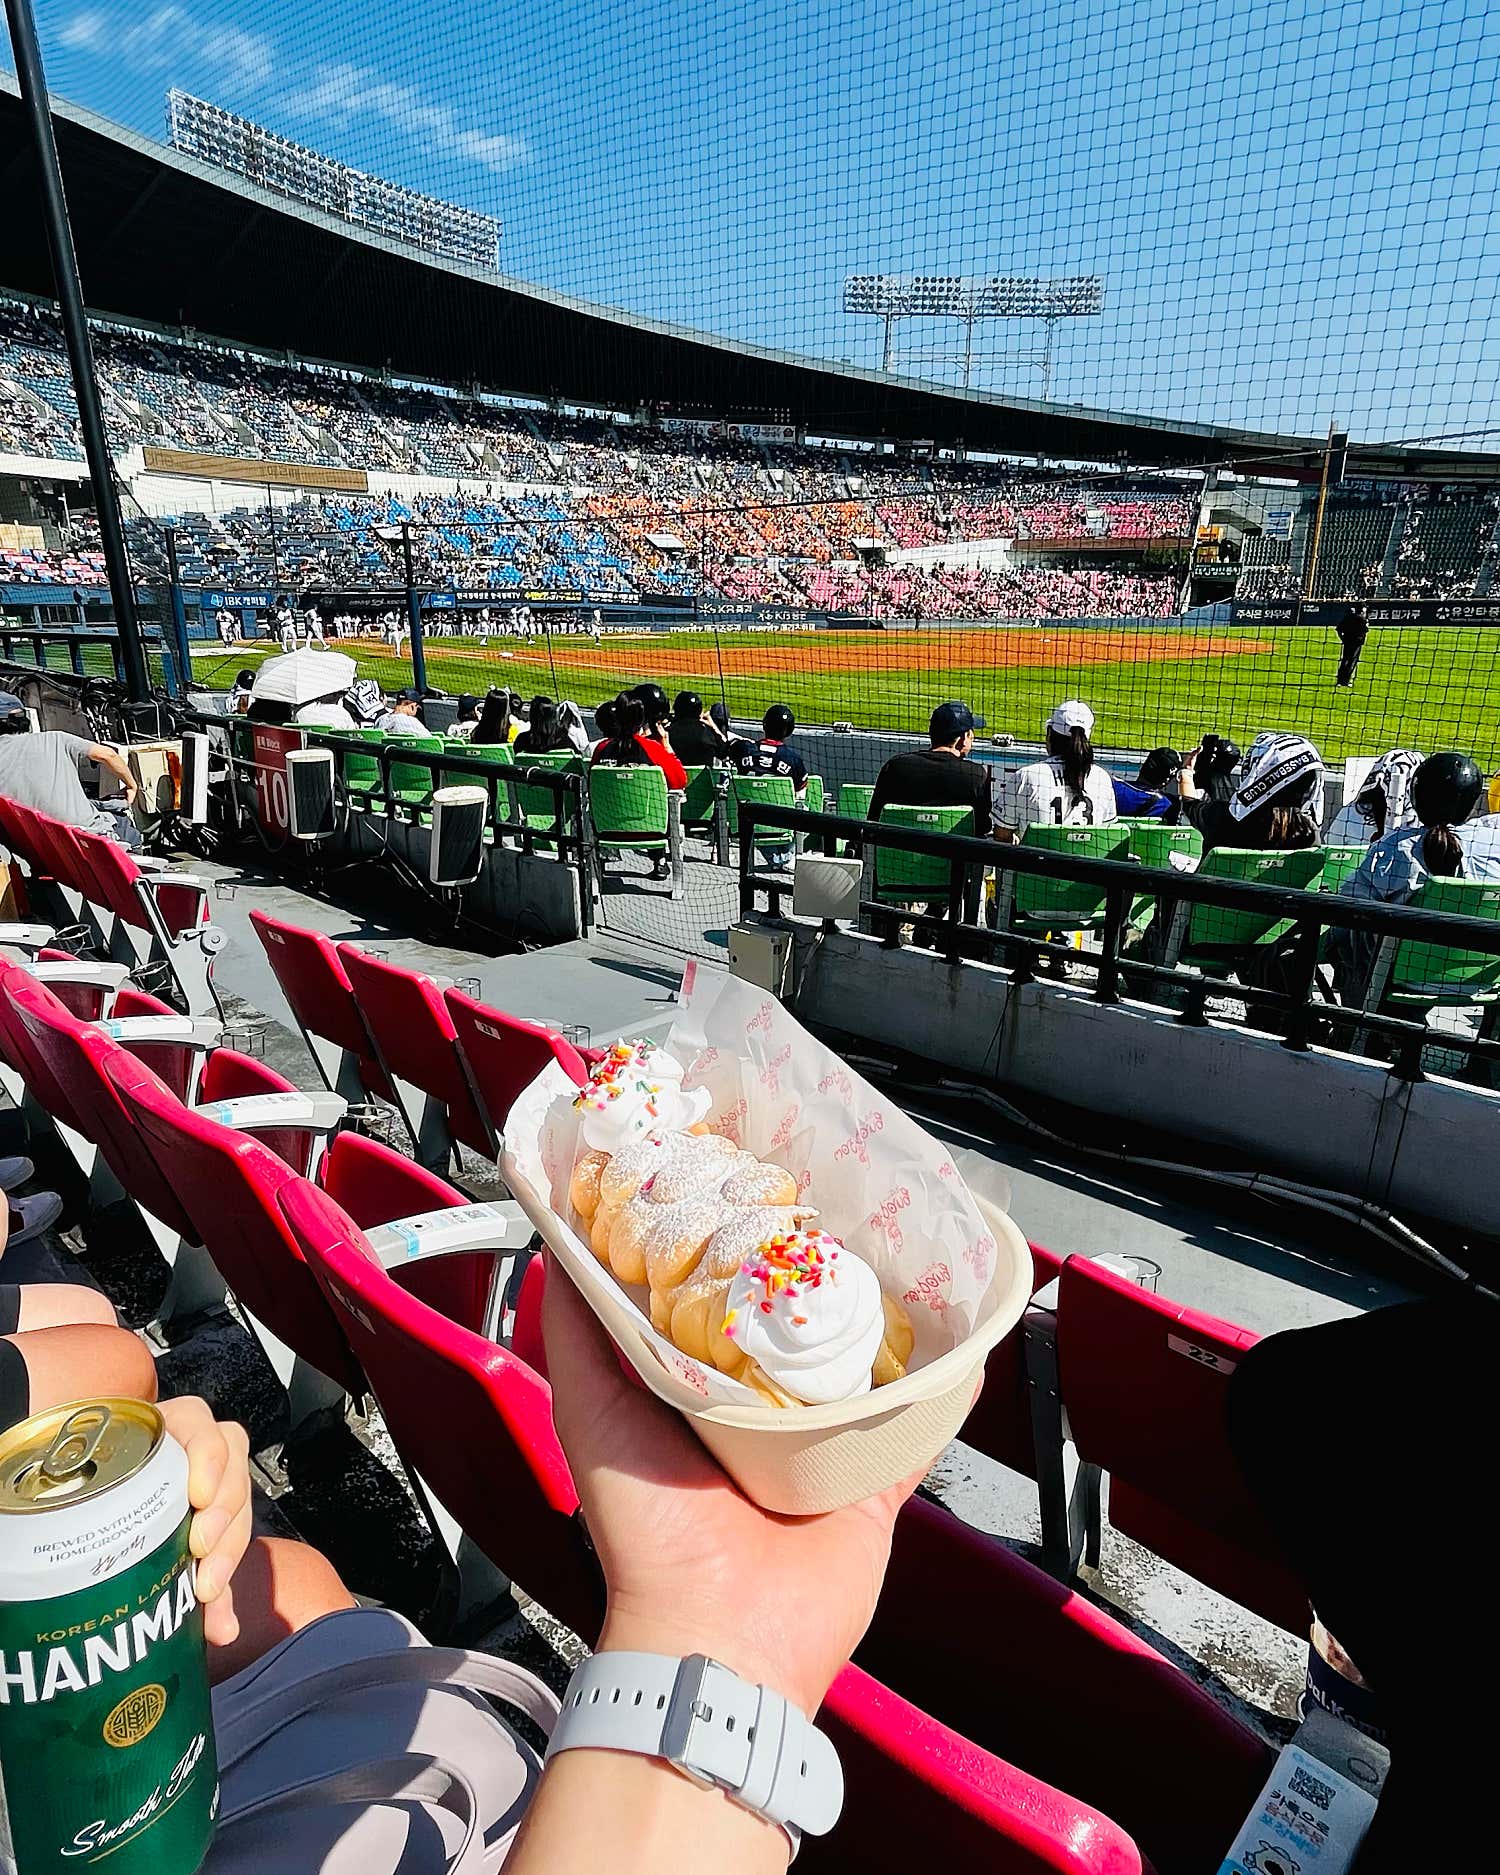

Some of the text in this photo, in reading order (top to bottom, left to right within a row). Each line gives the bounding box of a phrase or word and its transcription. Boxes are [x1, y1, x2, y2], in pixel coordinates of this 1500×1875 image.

[1242, 782, 1268, 801] CLUB
[1188, 1345, 1220, 1368] 22
[33, 1481, 171, 1555] BREWED WITH KOREAN
[49, 1518, 143, 1564] HOMEGROWN
[143, 1499, 168, 1521] RICE
[0, 1557, 198, 1704] HANMA
[36, 1602, 130, 1645] KOREAN
[60, 1784, 163, 1857] Smooth
